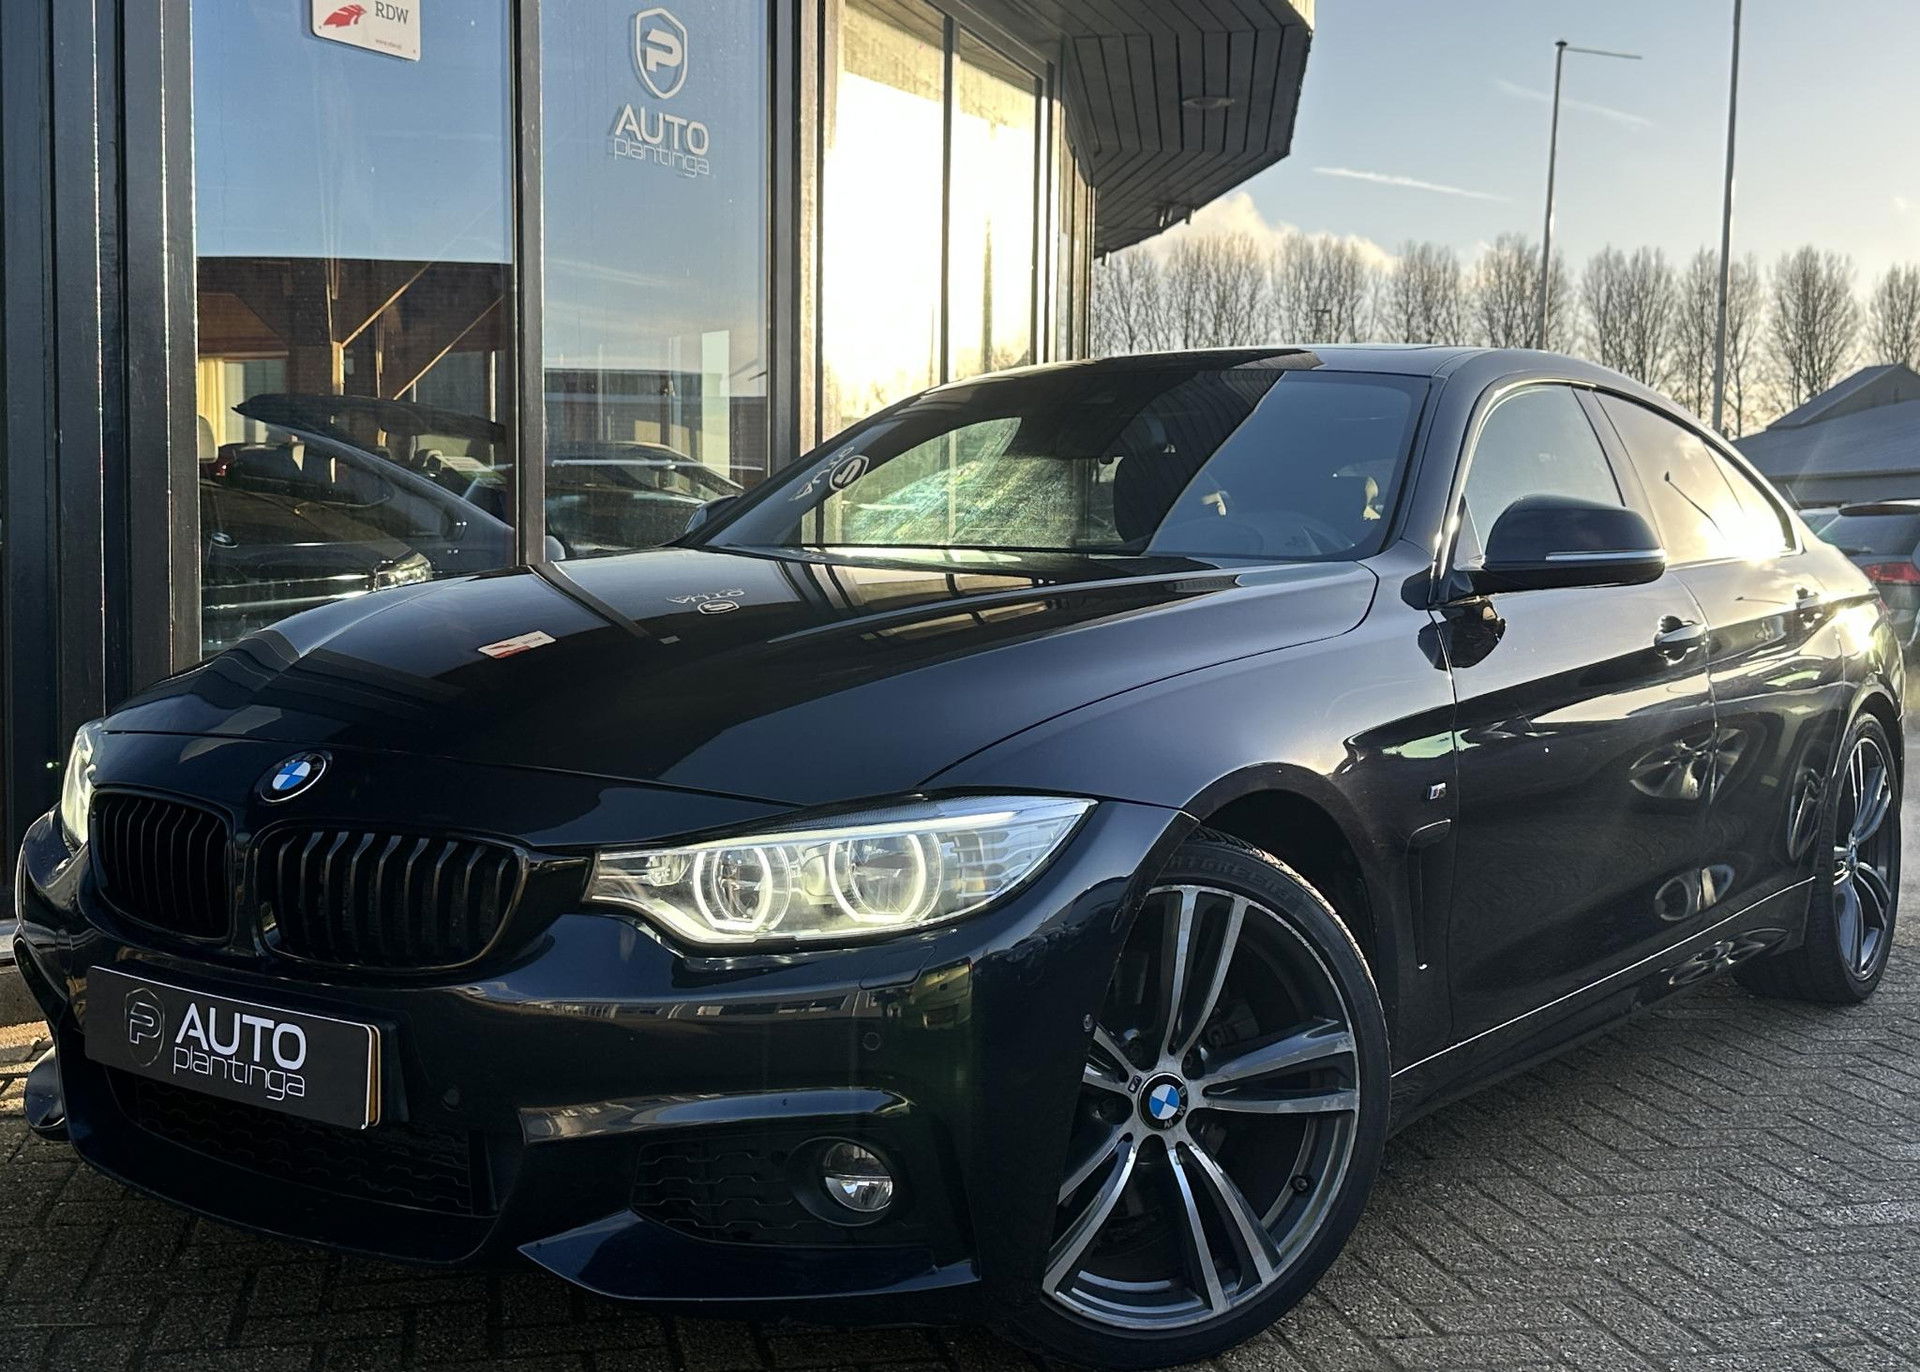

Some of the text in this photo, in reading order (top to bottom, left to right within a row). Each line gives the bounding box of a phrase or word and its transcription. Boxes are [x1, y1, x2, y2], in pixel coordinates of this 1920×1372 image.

[375, 1, 409, 24] RDW
[615, 103, 710, 156] AUTO
[614, 137, 710, 179] plantinga
[175, 1002, 307, 1071] AUTO
[173, 1045, 305, 1101] plantinga
